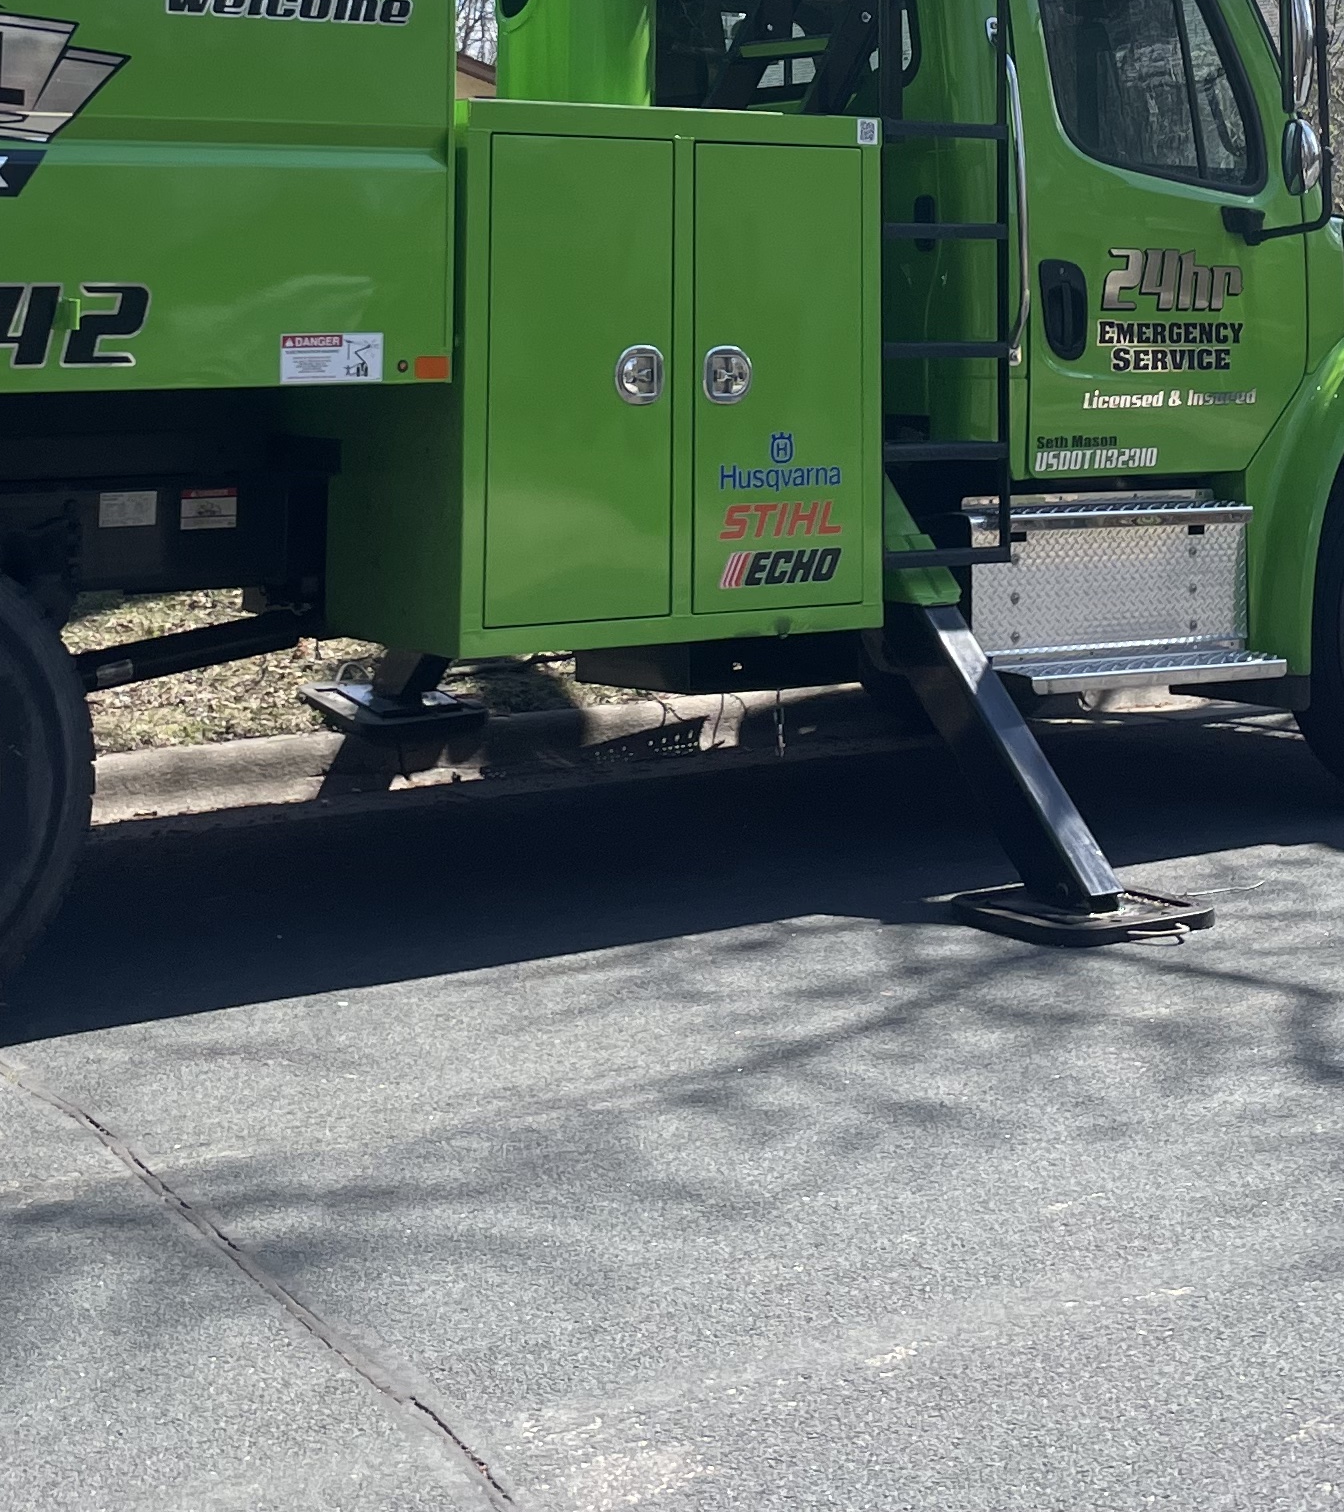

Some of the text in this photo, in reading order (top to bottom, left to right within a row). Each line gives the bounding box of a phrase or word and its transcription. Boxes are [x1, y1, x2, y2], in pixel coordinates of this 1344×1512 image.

[1101, 248, 1244, 312] 24hr
[295, 336, 340, 347] DANGER
[1097, 320, 1244, 346] EMERGENCY
[1111, 346, 1232, 373] SERVICE
[1082, 388, 1256, 410] Licensed & Insured
[1036, 435, 1117, 449] Seth Mason
[719, 464, 841, 492] Husqvarna
[719, 501, 842, 540] STIHL
[745, 547, 842, 587] ECHO
